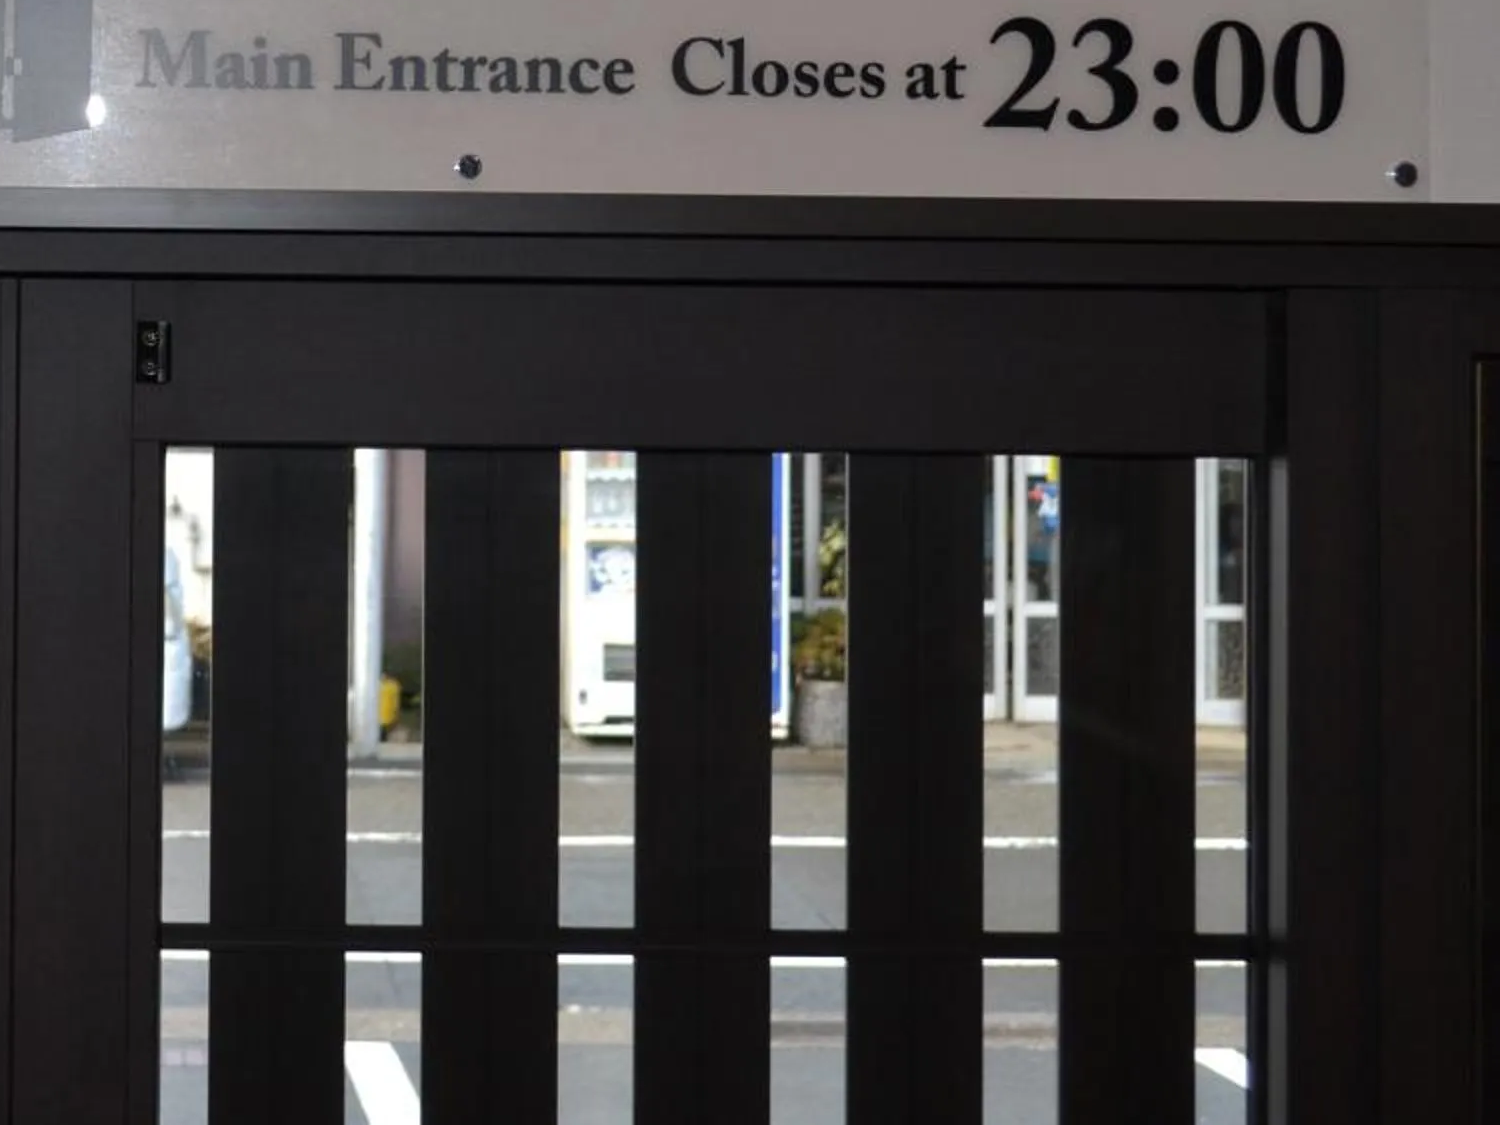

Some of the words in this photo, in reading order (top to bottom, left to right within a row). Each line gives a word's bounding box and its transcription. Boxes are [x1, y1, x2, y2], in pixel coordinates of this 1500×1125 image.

[135, 28, 315, 90] Main
[334, 32, 636, 95] Entrance
[670, 36, 887, 99] Closes
[904, 53, 967, 100] at
[982, 16, 1346, 135] 23:00
